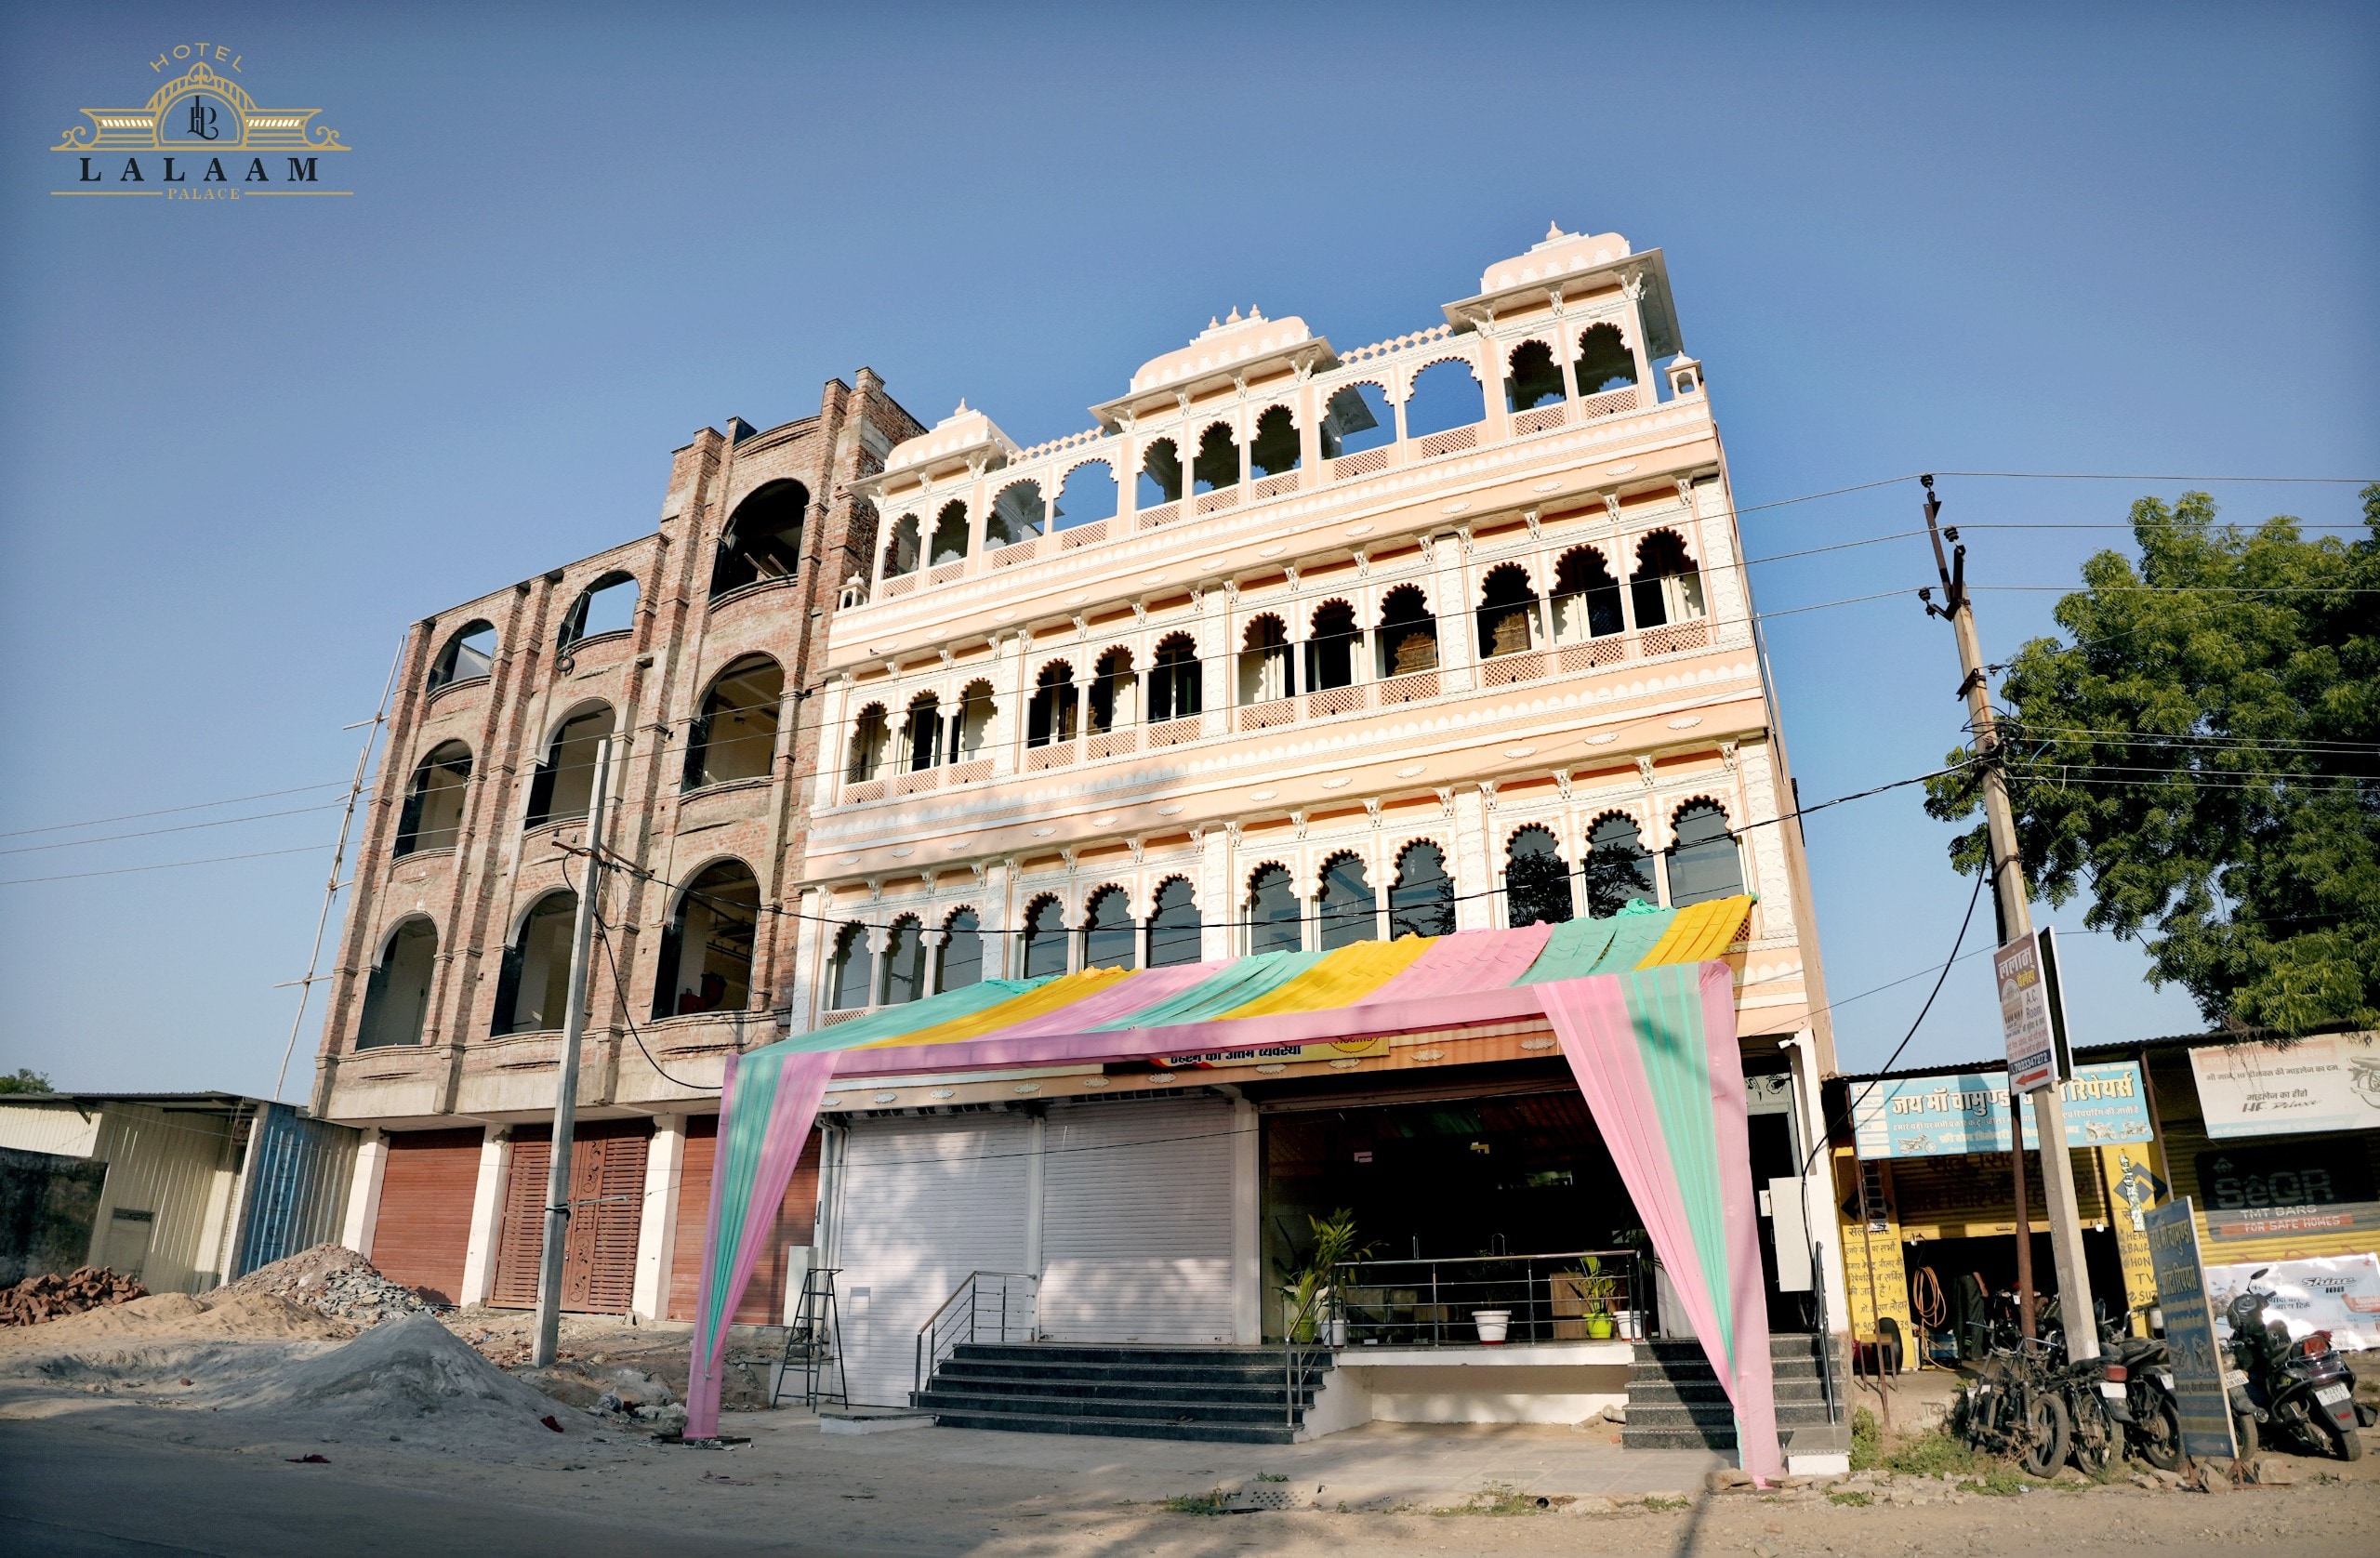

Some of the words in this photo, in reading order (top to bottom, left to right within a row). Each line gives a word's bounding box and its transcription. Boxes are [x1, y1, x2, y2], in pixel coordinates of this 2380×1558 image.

[2026, 1005, 2043, 1021] Room
[2069, 1071, 2135, 1102] रिपेयर्स
[2280, 1090, 2290, 1100] का
[1890, 1094, 1924, 1115] जय
[1950, 1089, 2011, 1116] चामुण्ड
[2241, 1101, 2265, 1113] HF
[2271, 1099, 2321, 1111] Deluxe
[2240, 1208, 2270, 1220] TMT
[2275, 1205, 2318, 1217] BARS
[2244, 1223, 2264, 1233] FOR
[2268, 1219, 2299, 1231] SAFE
[2303, 1216, 2341, 1228] HOMES
[2128, 1243, 2150, 1254] BAJA
[2130, 1257, 2151, 1267] HON
[2135, 1274, 2156, 1285] TV
[2301, 1276, 2356, 1287] Shine
[2139, 1290, 2158, 1302] SUZ
